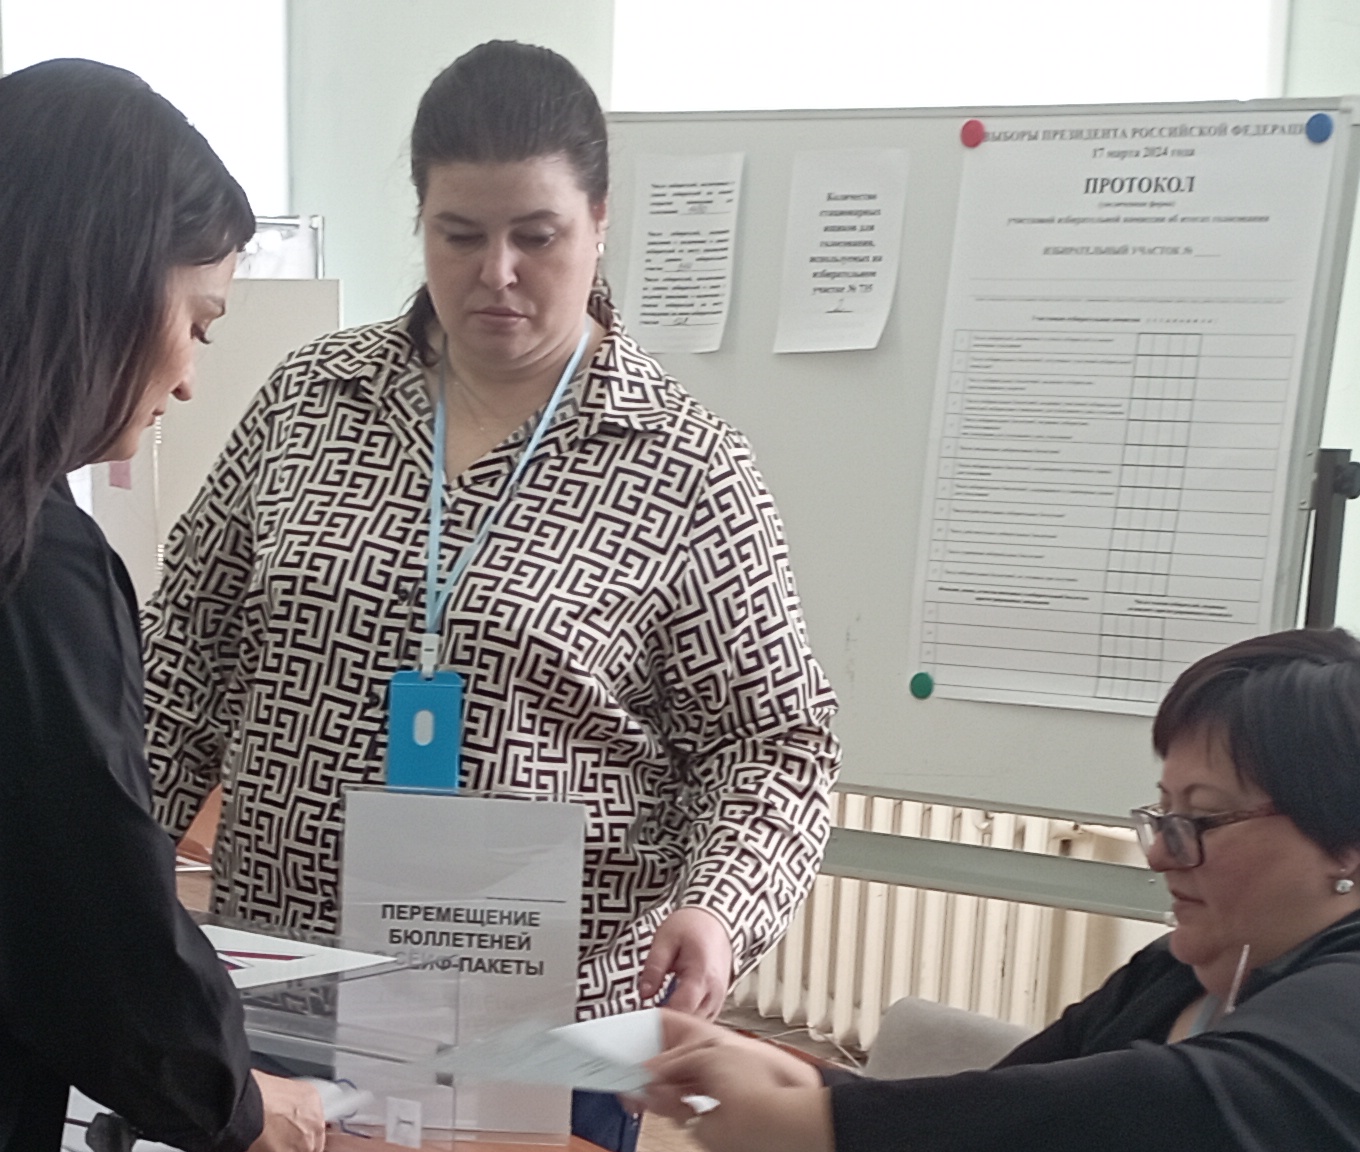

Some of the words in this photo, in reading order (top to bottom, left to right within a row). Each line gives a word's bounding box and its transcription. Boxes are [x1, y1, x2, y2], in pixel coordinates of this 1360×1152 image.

[1041, 126, 1128, 141] ПРЕЗИДЕНТА
[1130, 122, 1228, 139] РОССИЙСКОЙ
[1231, 122, 1307, 137] ФЕДЕРАЦИ
[1092, 147, 1105, 159] 17
[1083, 175, 1196, 195] ПРОТОКОЛ
[380, 903, 541, 927] ПЕРЕМЕЩЕНИЕ
[388, 927, 533, 952] БЮЛЛЕТЕНЕЙ
